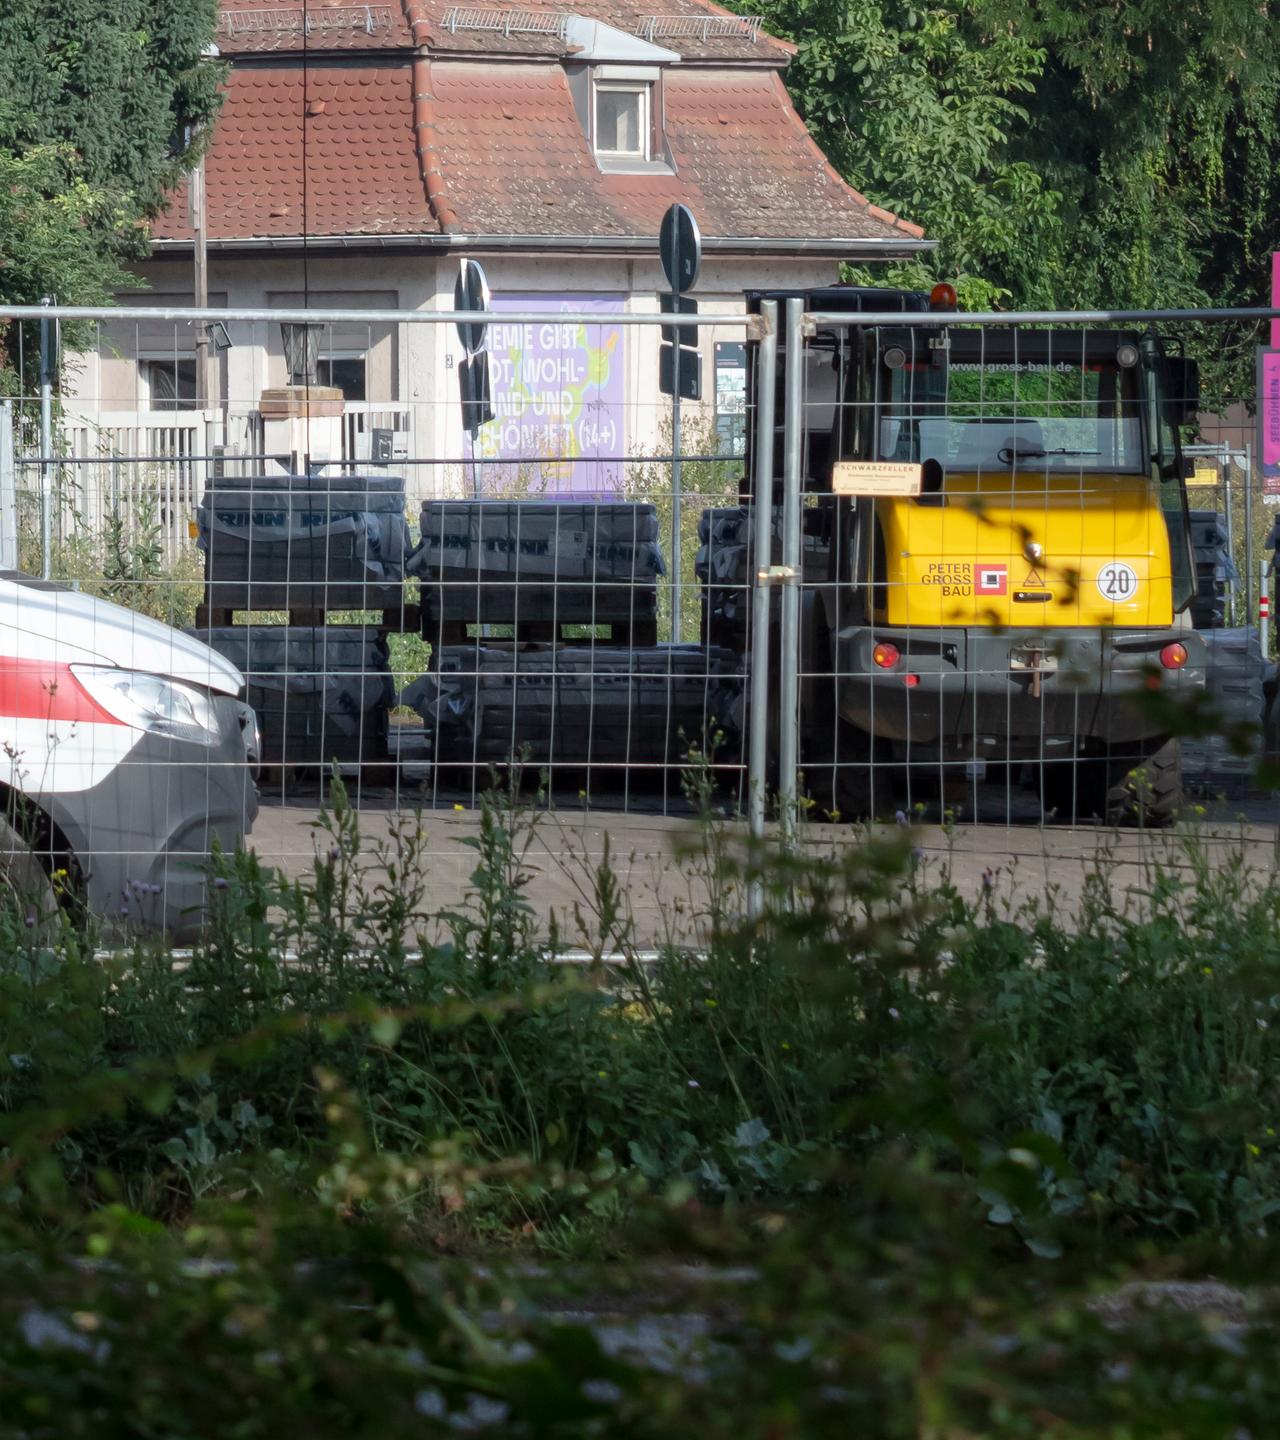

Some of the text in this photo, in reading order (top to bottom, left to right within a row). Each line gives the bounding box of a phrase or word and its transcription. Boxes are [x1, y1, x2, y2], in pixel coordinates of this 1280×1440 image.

[928, 563, 971, 574] PETER
[921, 574, 971, 585] GROSS
[1106, 569, 1130, 594] 20
[942, 586, 971, 597] BAU
